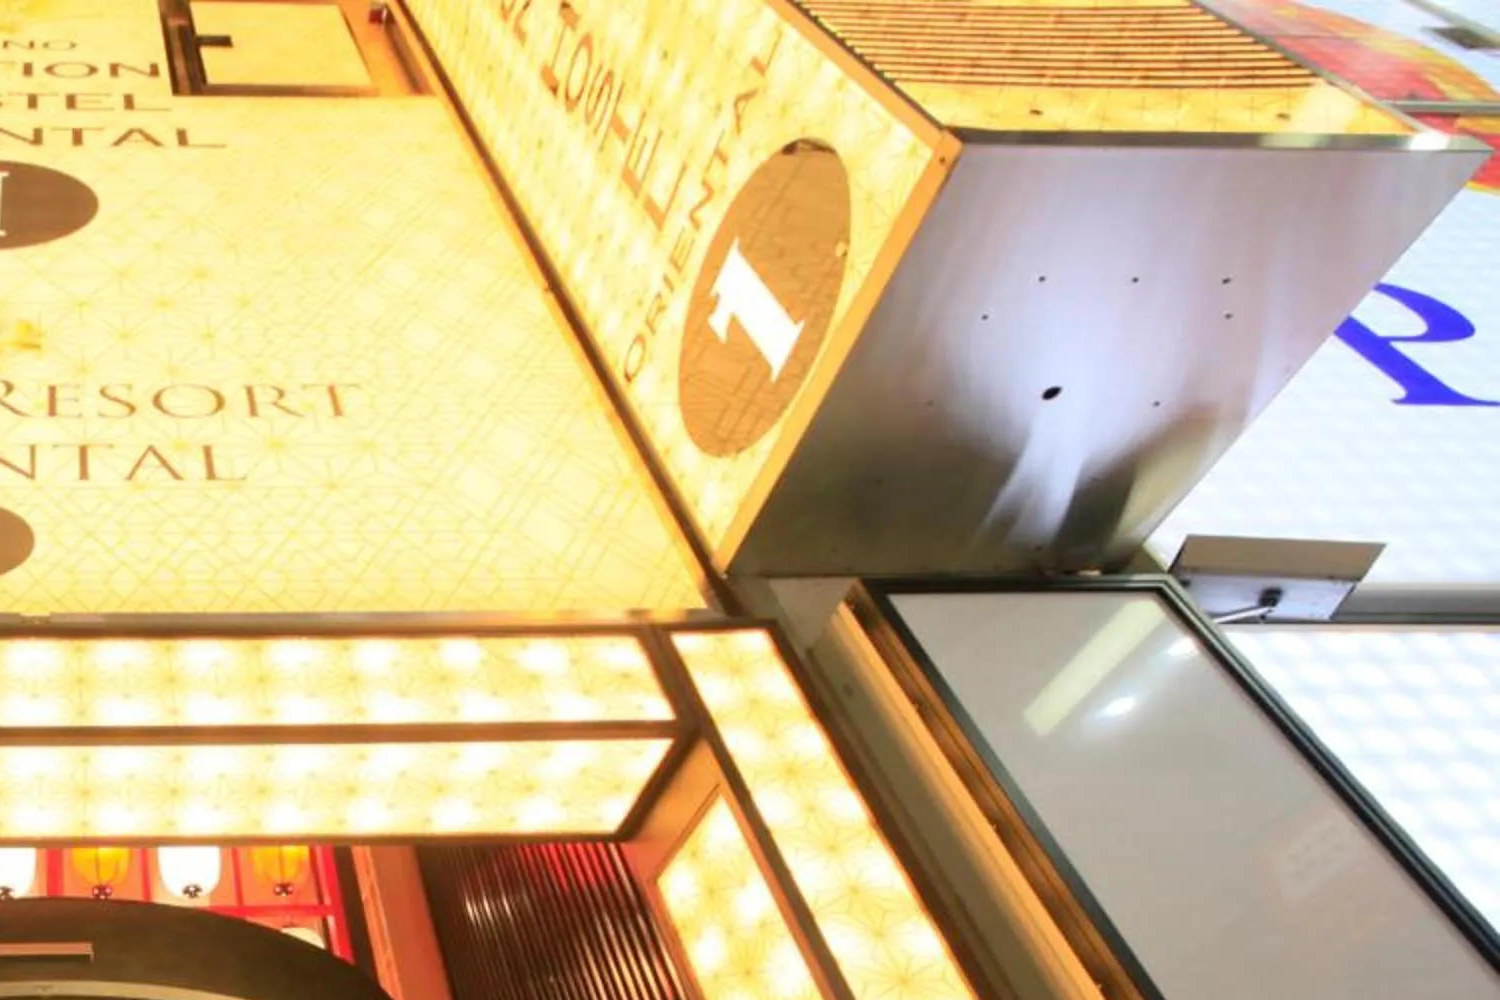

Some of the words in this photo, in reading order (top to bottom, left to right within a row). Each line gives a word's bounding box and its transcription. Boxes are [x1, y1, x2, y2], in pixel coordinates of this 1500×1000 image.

[540, 0, 688, 233] HOSTEL
[622, 20, 784, 386] ORIENTAL
[707, 236, 805, 384] 1
